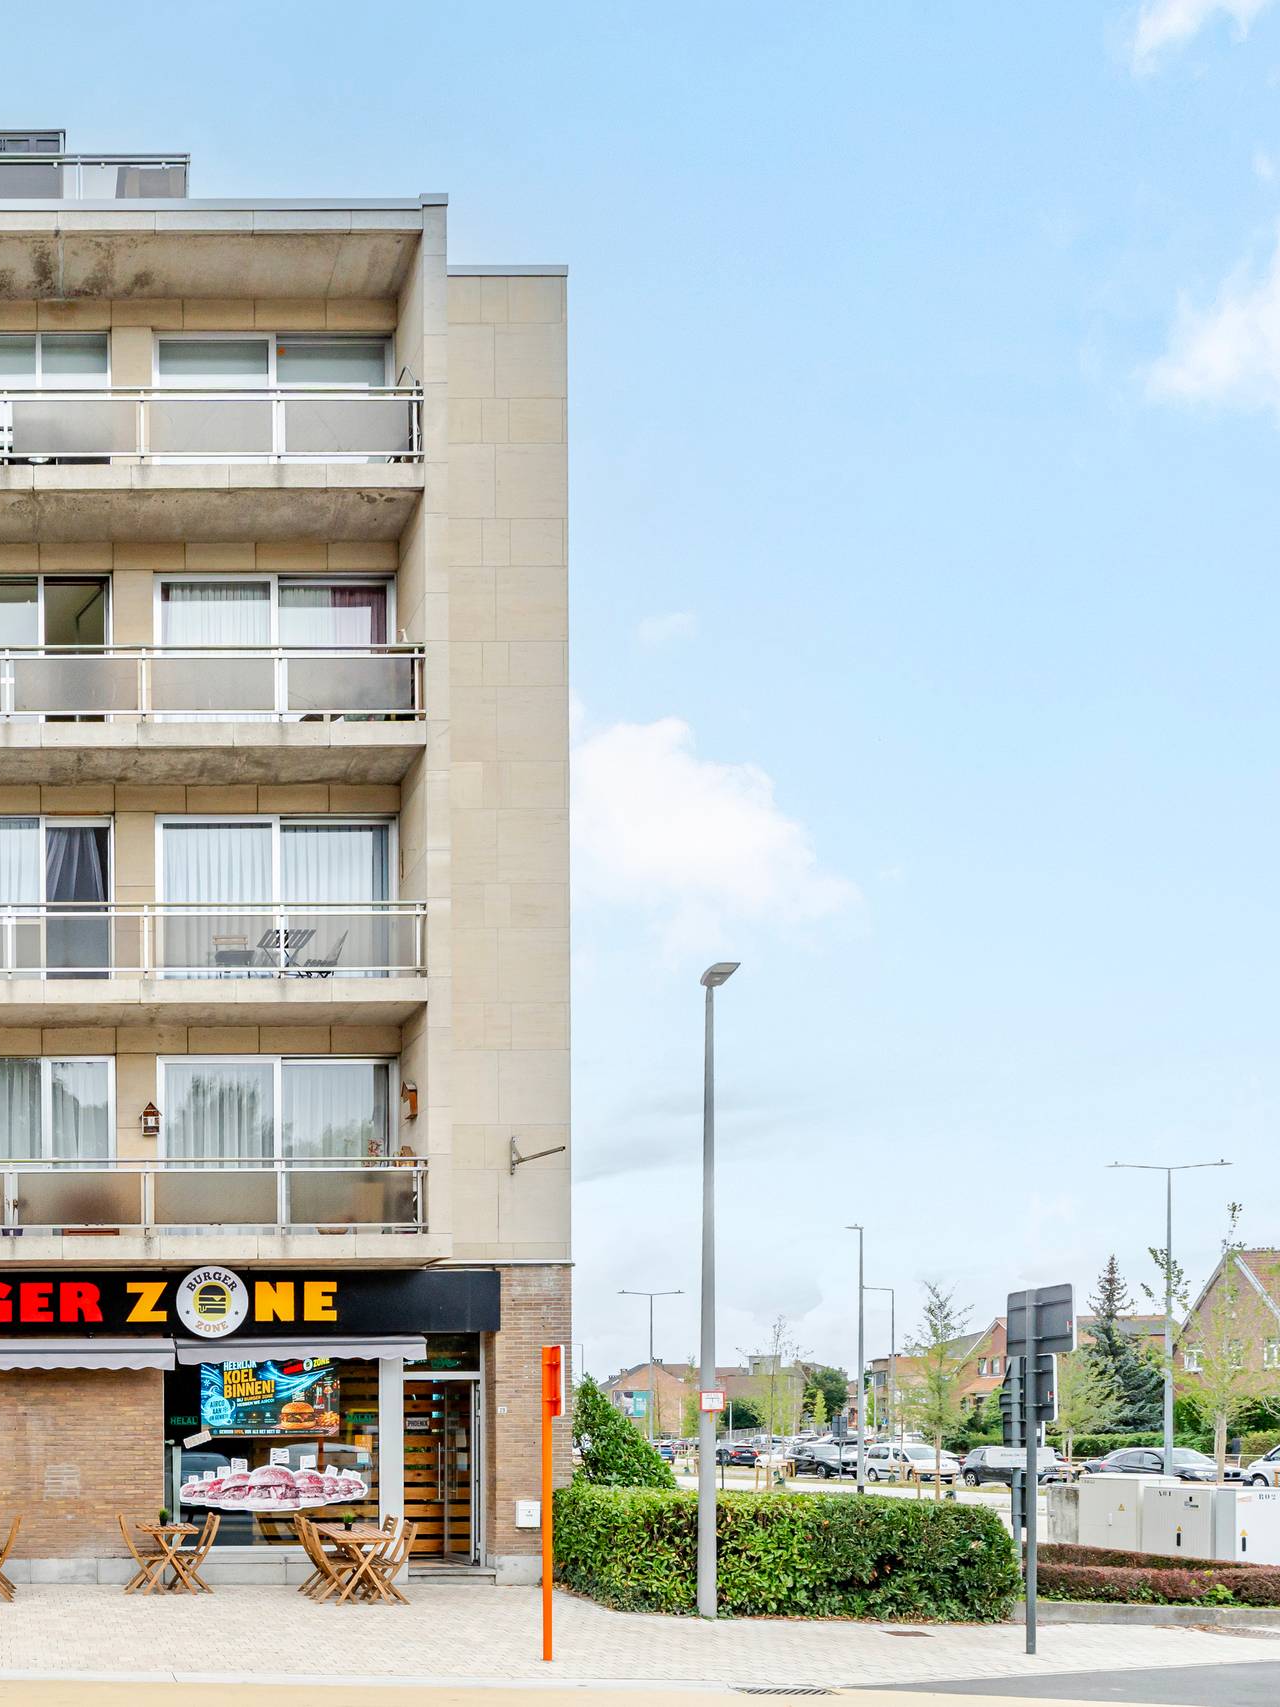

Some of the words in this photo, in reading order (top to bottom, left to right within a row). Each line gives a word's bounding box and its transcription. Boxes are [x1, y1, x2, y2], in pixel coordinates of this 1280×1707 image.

[186, 1271, 238, 1293] BURGER
[195, 1320, 229, 1333] ZONE
[223, 1368, 256, 1384] KOEL
[223, 1379, 275, 1399] BINNEN!
